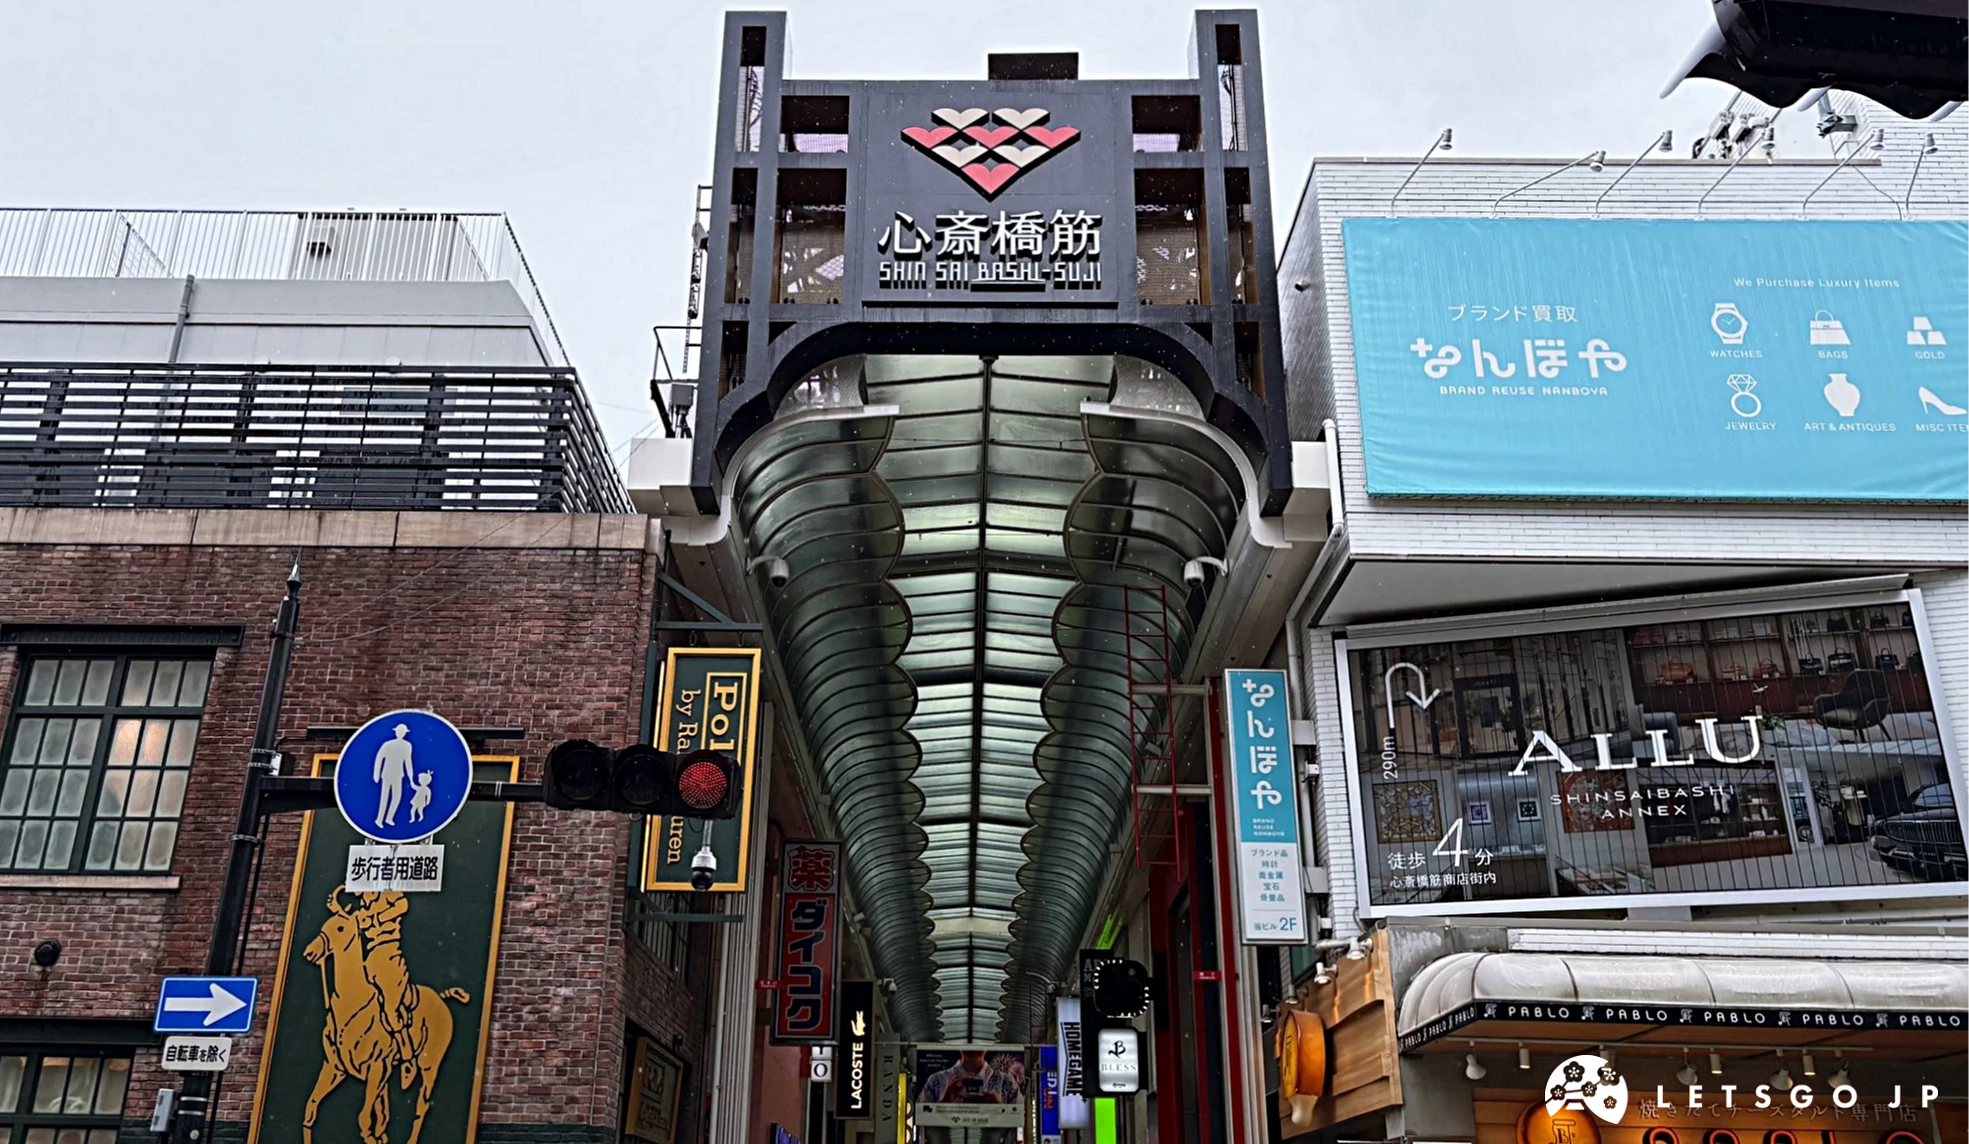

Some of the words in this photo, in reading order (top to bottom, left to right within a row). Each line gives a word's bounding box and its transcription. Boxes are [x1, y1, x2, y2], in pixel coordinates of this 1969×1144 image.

[878, 209, 1102, 256] 心斎橋筋
[879, 262, 926, 281] SHIN
[936, 262, 969, 281] SAI
[1733, 278, 1752, 287] We
[1757, 278, 1814, 287] Purchase
[1819, 278, 1860, 289] Luxury
[1865, 278, 1900, 287] Items
[1448, 304, 1577, 323] ブランド買取
[1410, 337, 1627, 379] なんぼや
[1709, 350, 1763, 358] WATCHES
[1818, 351, 1848, 359] BAGS
[1915, 351, 1945, 359] GOLD
[1440, 386, 1486, 395] BRAND
[1492, 386, 1535, 395] REUSE
[1542, 387, 1608, 396] NANBOYA
[1725, 423, 1777, 431] JEWELRY
[1804, 423, 1826, 431] ART
[1829, 423, 1836, 431] &
[1839, 424, 1896, 432] ANTIQUES
[1915, 423, 1944, 432] MISC
[676, 689, 701, 715] by
[710, 682, 738, 750] Pol
[1242, 679, 1282, 810] なんぼや
[1508, 715, 1763, 776] ALLU
[1381, 736, 1398, 780] 290m
[1550, 785, 1734, 805] SHINSAIBASHI
[1602, 805, 1687, 819] ANNEX
[667, 815, 684, 864] uren
[1251, 849, 1288, 857] ブランド品
[351, 856, 439, 881] 歩行者用道路
[787, 846, 834, 891] 薬
[1263, 883, 1280, 891] 宝石
[1280, 917, 1297, 931] 2F
[786, 898, 828, 1031] ダイコク
[1455, 1007, 1474, 1024] PABLO
[1509, 1007, 1569, 1018] PABLO
[1606, 1008, 1667, 1020] PABLO
[1704, 1012, 1765, 1023] PABLO
[1802, 1014, 1864, 1025] PABLO
[1900, 1015, 1961, 1027] PABLO
[1429, 1020, 1446, 1037] PABLO
[1405, 1033, 1421, 1048] PABLO
[165, 1045, 226, 1063] 自転車を除く
[1064, 1022, 1083, 1096] HOMEGAME
[1101, 1063, 1137, 1071] BLESS
[851, 1043, 863, 1109] LACOSTE
[882, 1056, 893, 1122] RANDA
